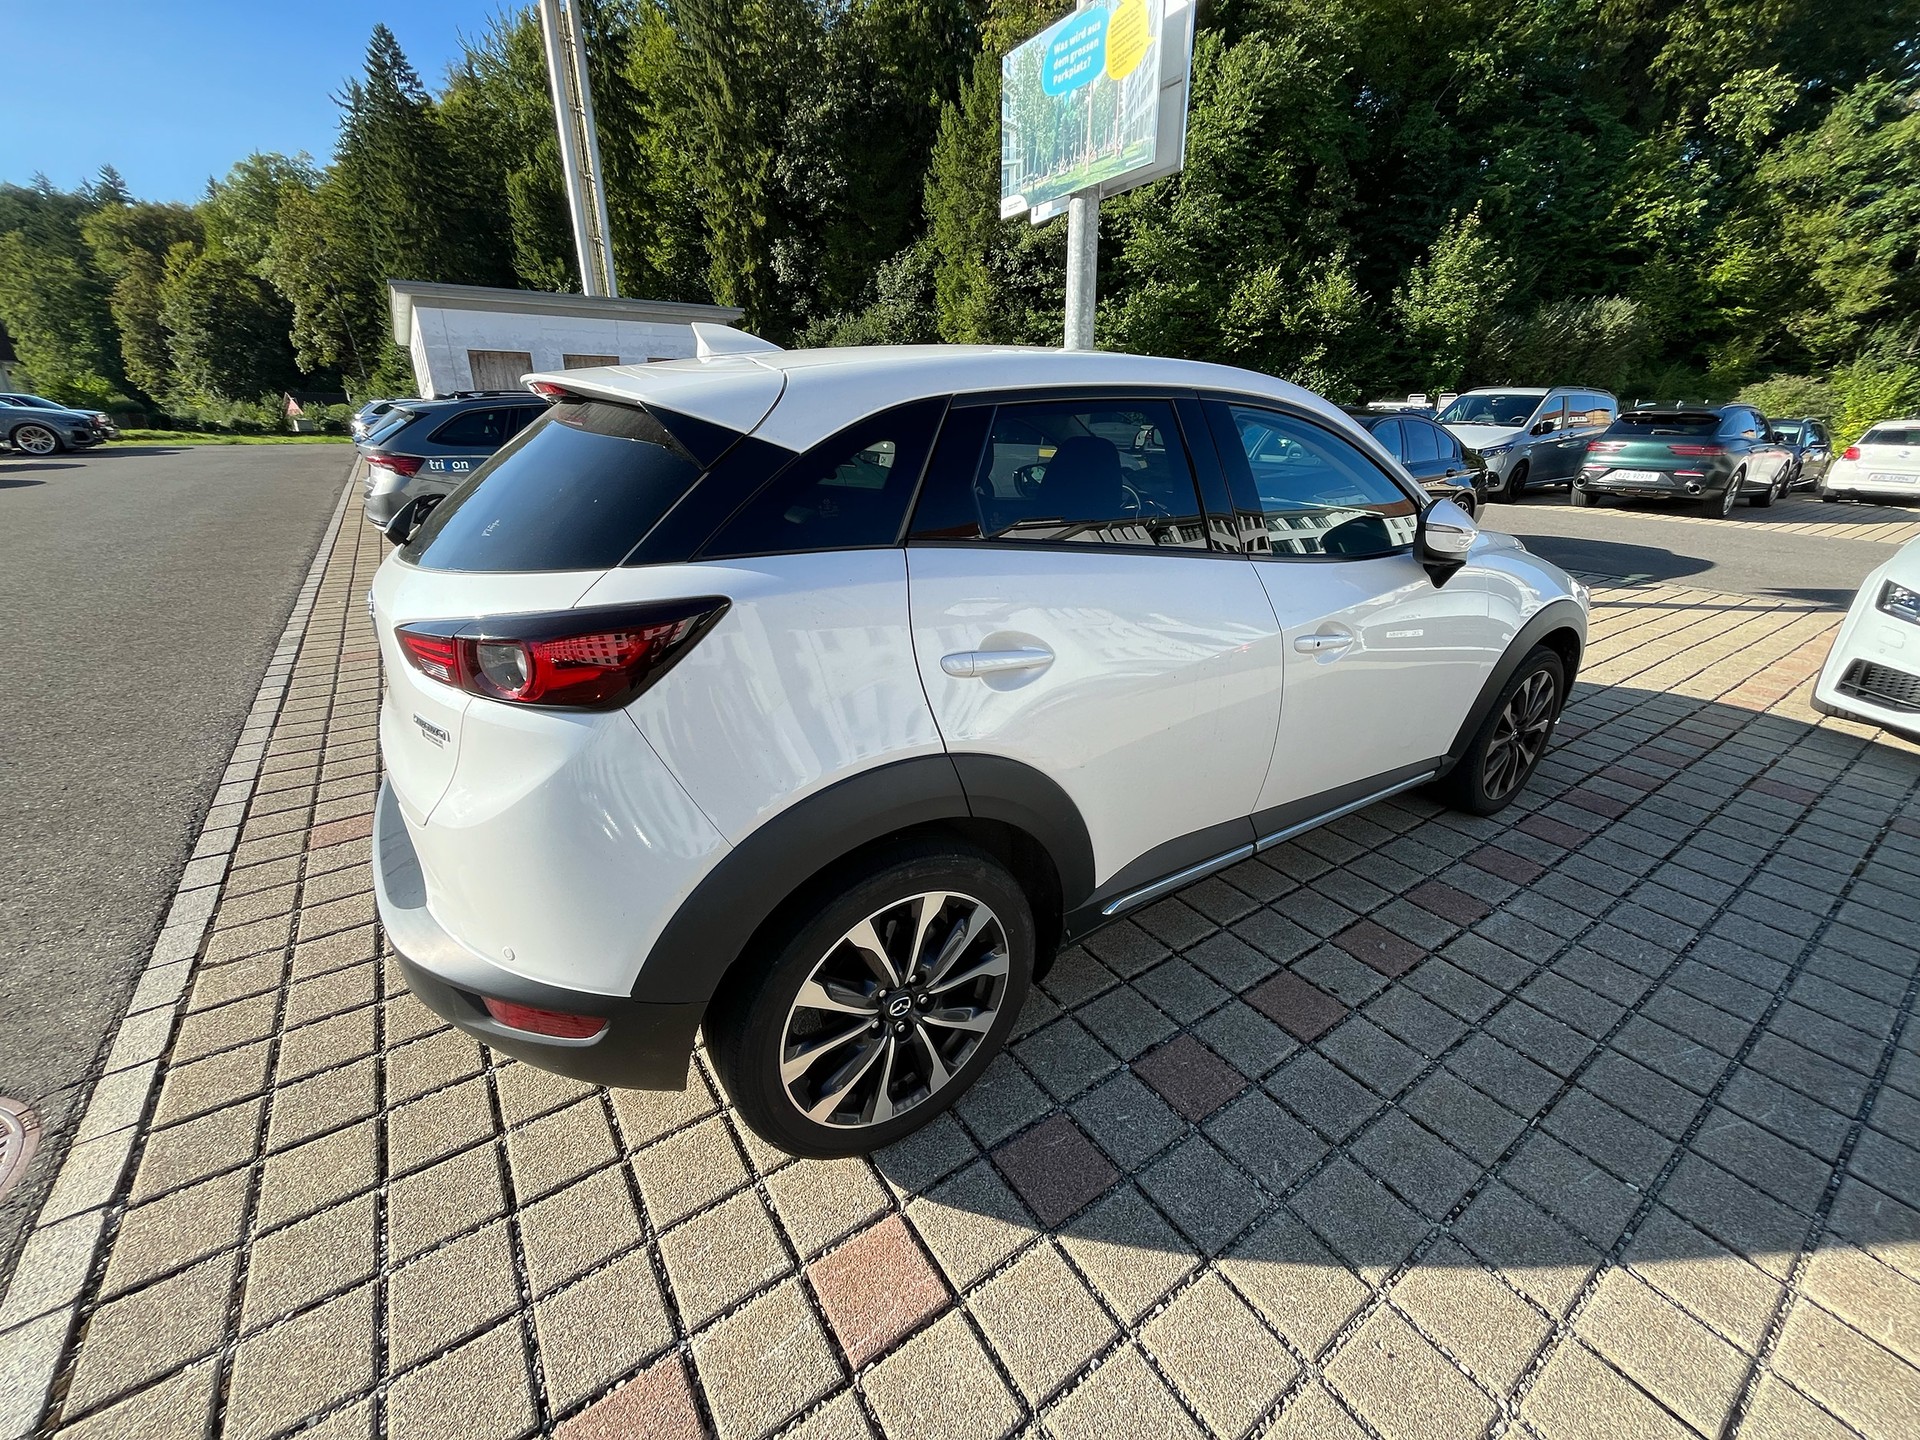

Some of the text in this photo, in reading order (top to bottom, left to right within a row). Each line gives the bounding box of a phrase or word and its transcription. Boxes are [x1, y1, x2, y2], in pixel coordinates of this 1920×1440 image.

[1053, 20, 1101, 55] Was wird aus
[1053, 38, 1099, 70] dem grossen
[1053, 56, 1092, 86] Parkplatz?
